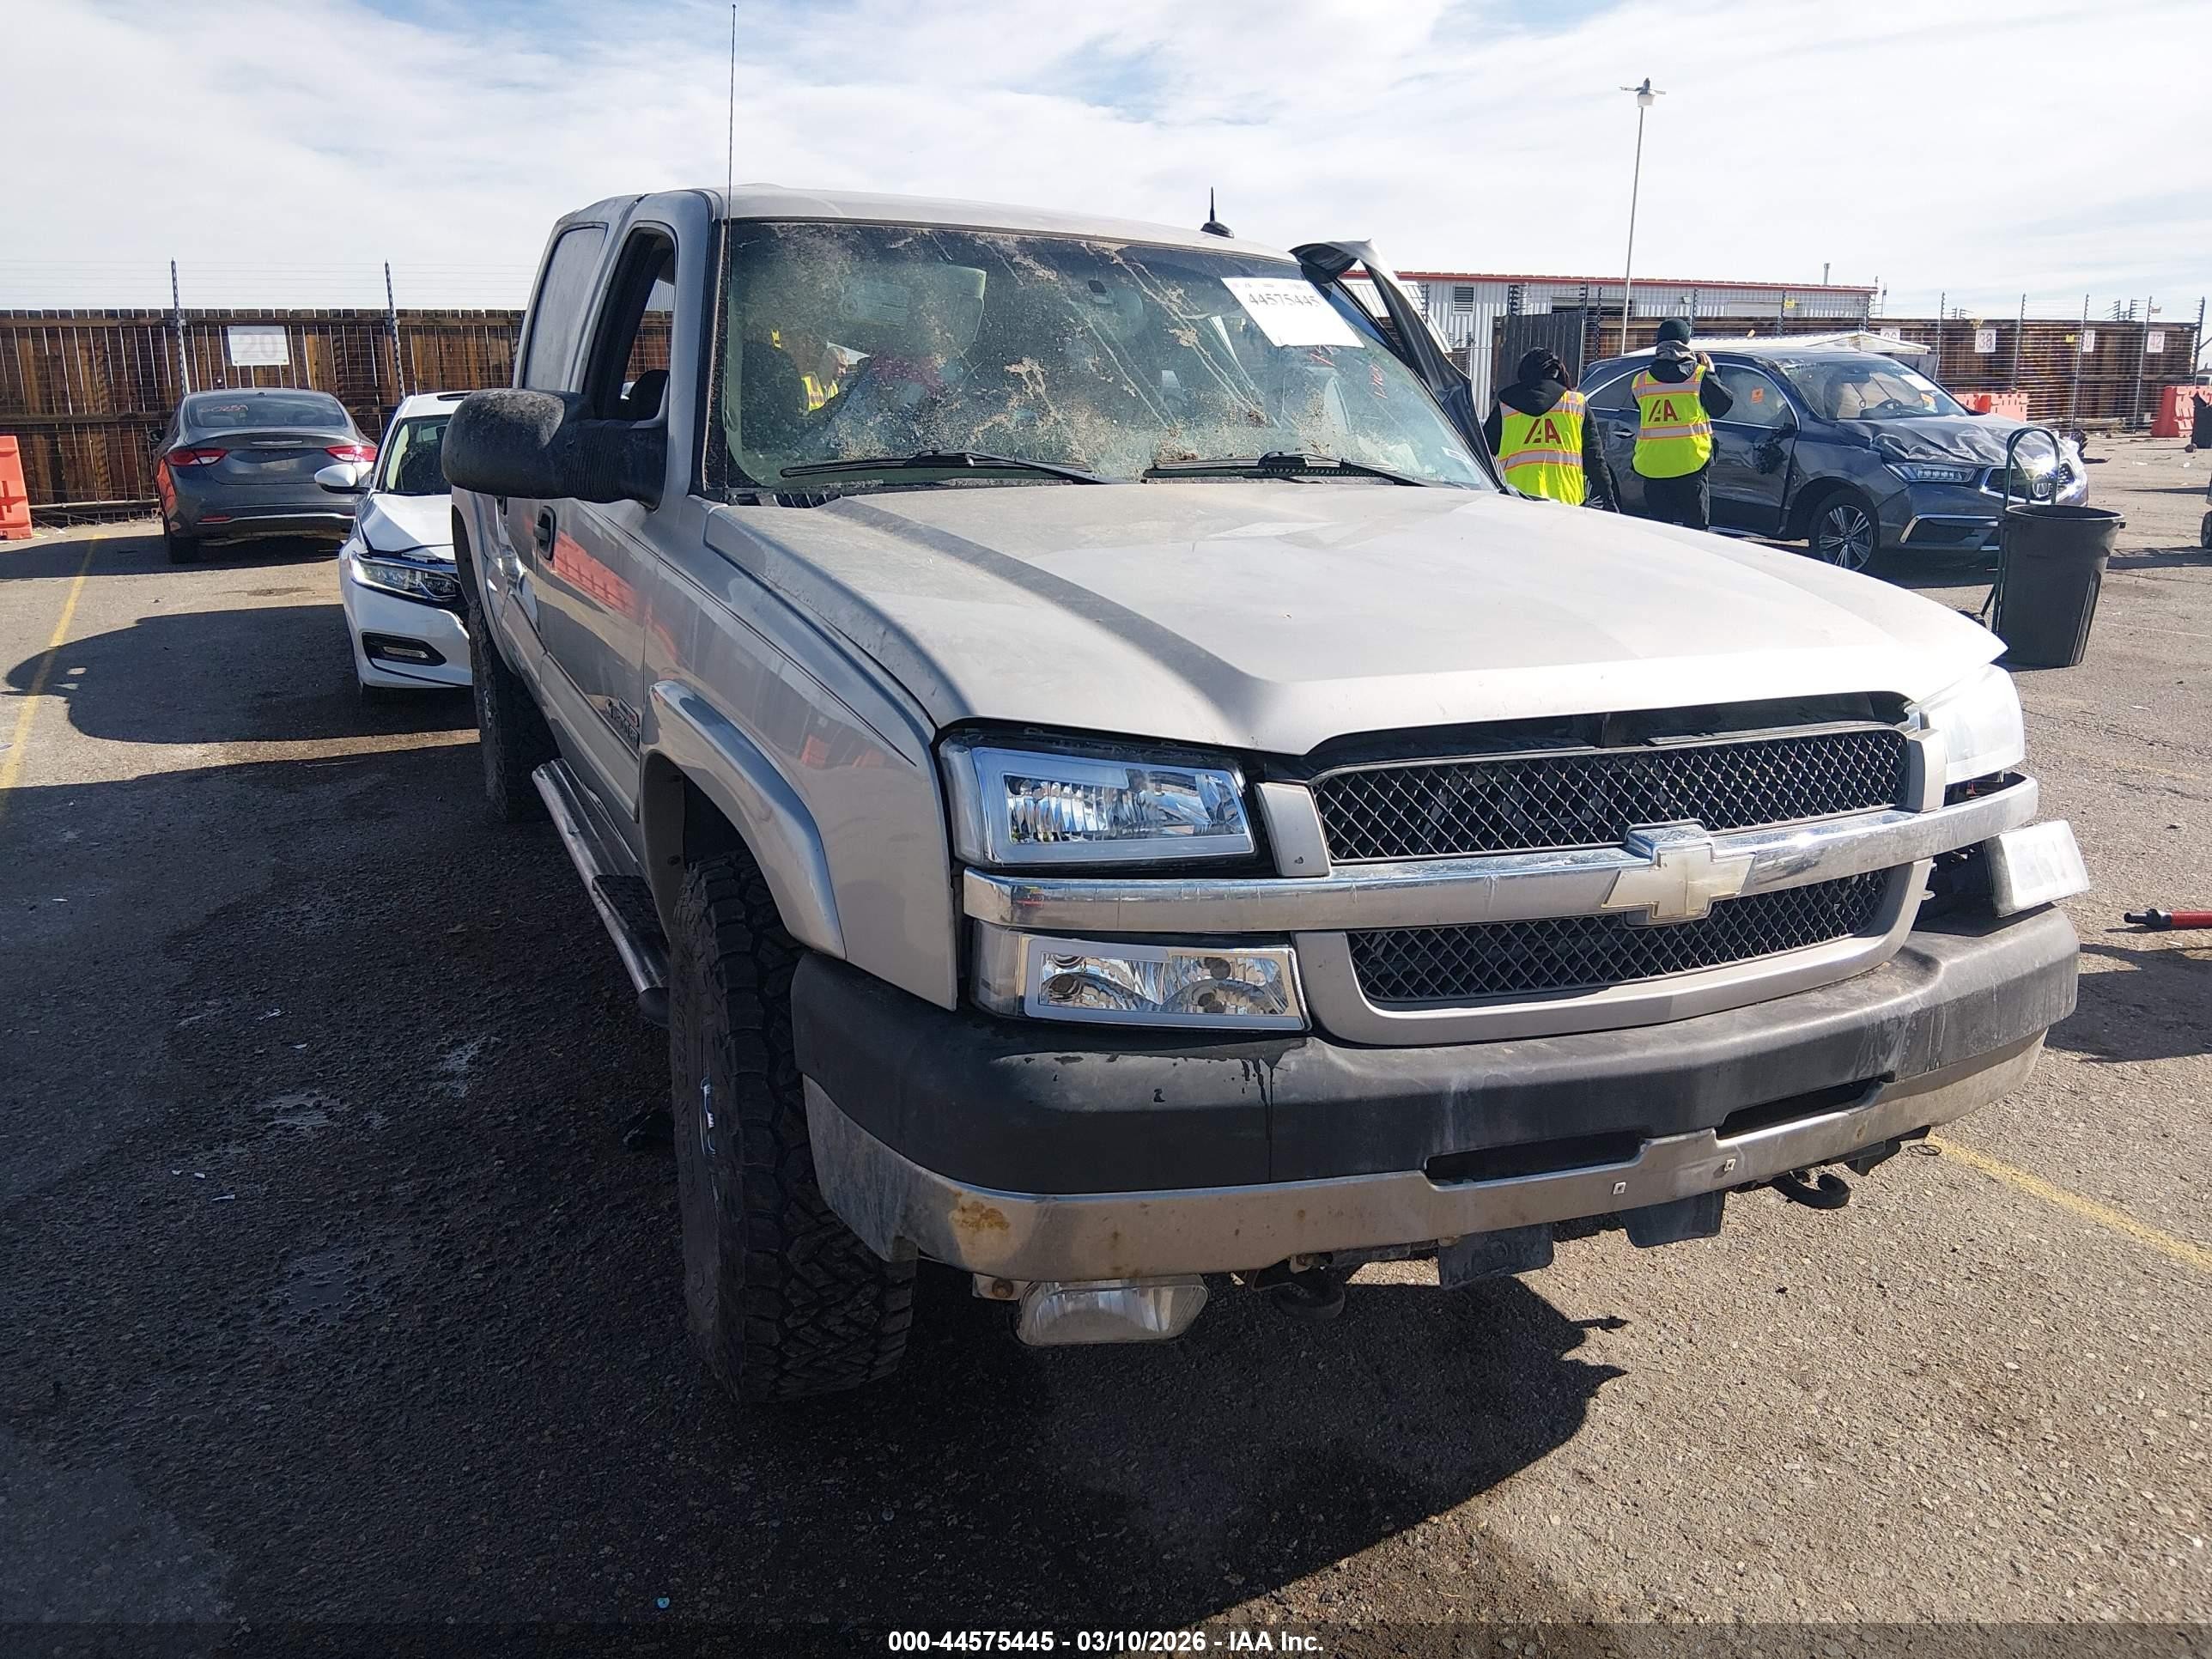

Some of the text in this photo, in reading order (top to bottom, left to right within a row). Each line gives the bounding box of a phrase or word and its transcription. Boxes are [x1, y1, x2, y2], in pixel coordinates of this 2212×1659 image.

[1249, 293, 1322, 307] 44575445
[239, 331, 278, 358] 20
[1978, 332, 1993, 349] 38
